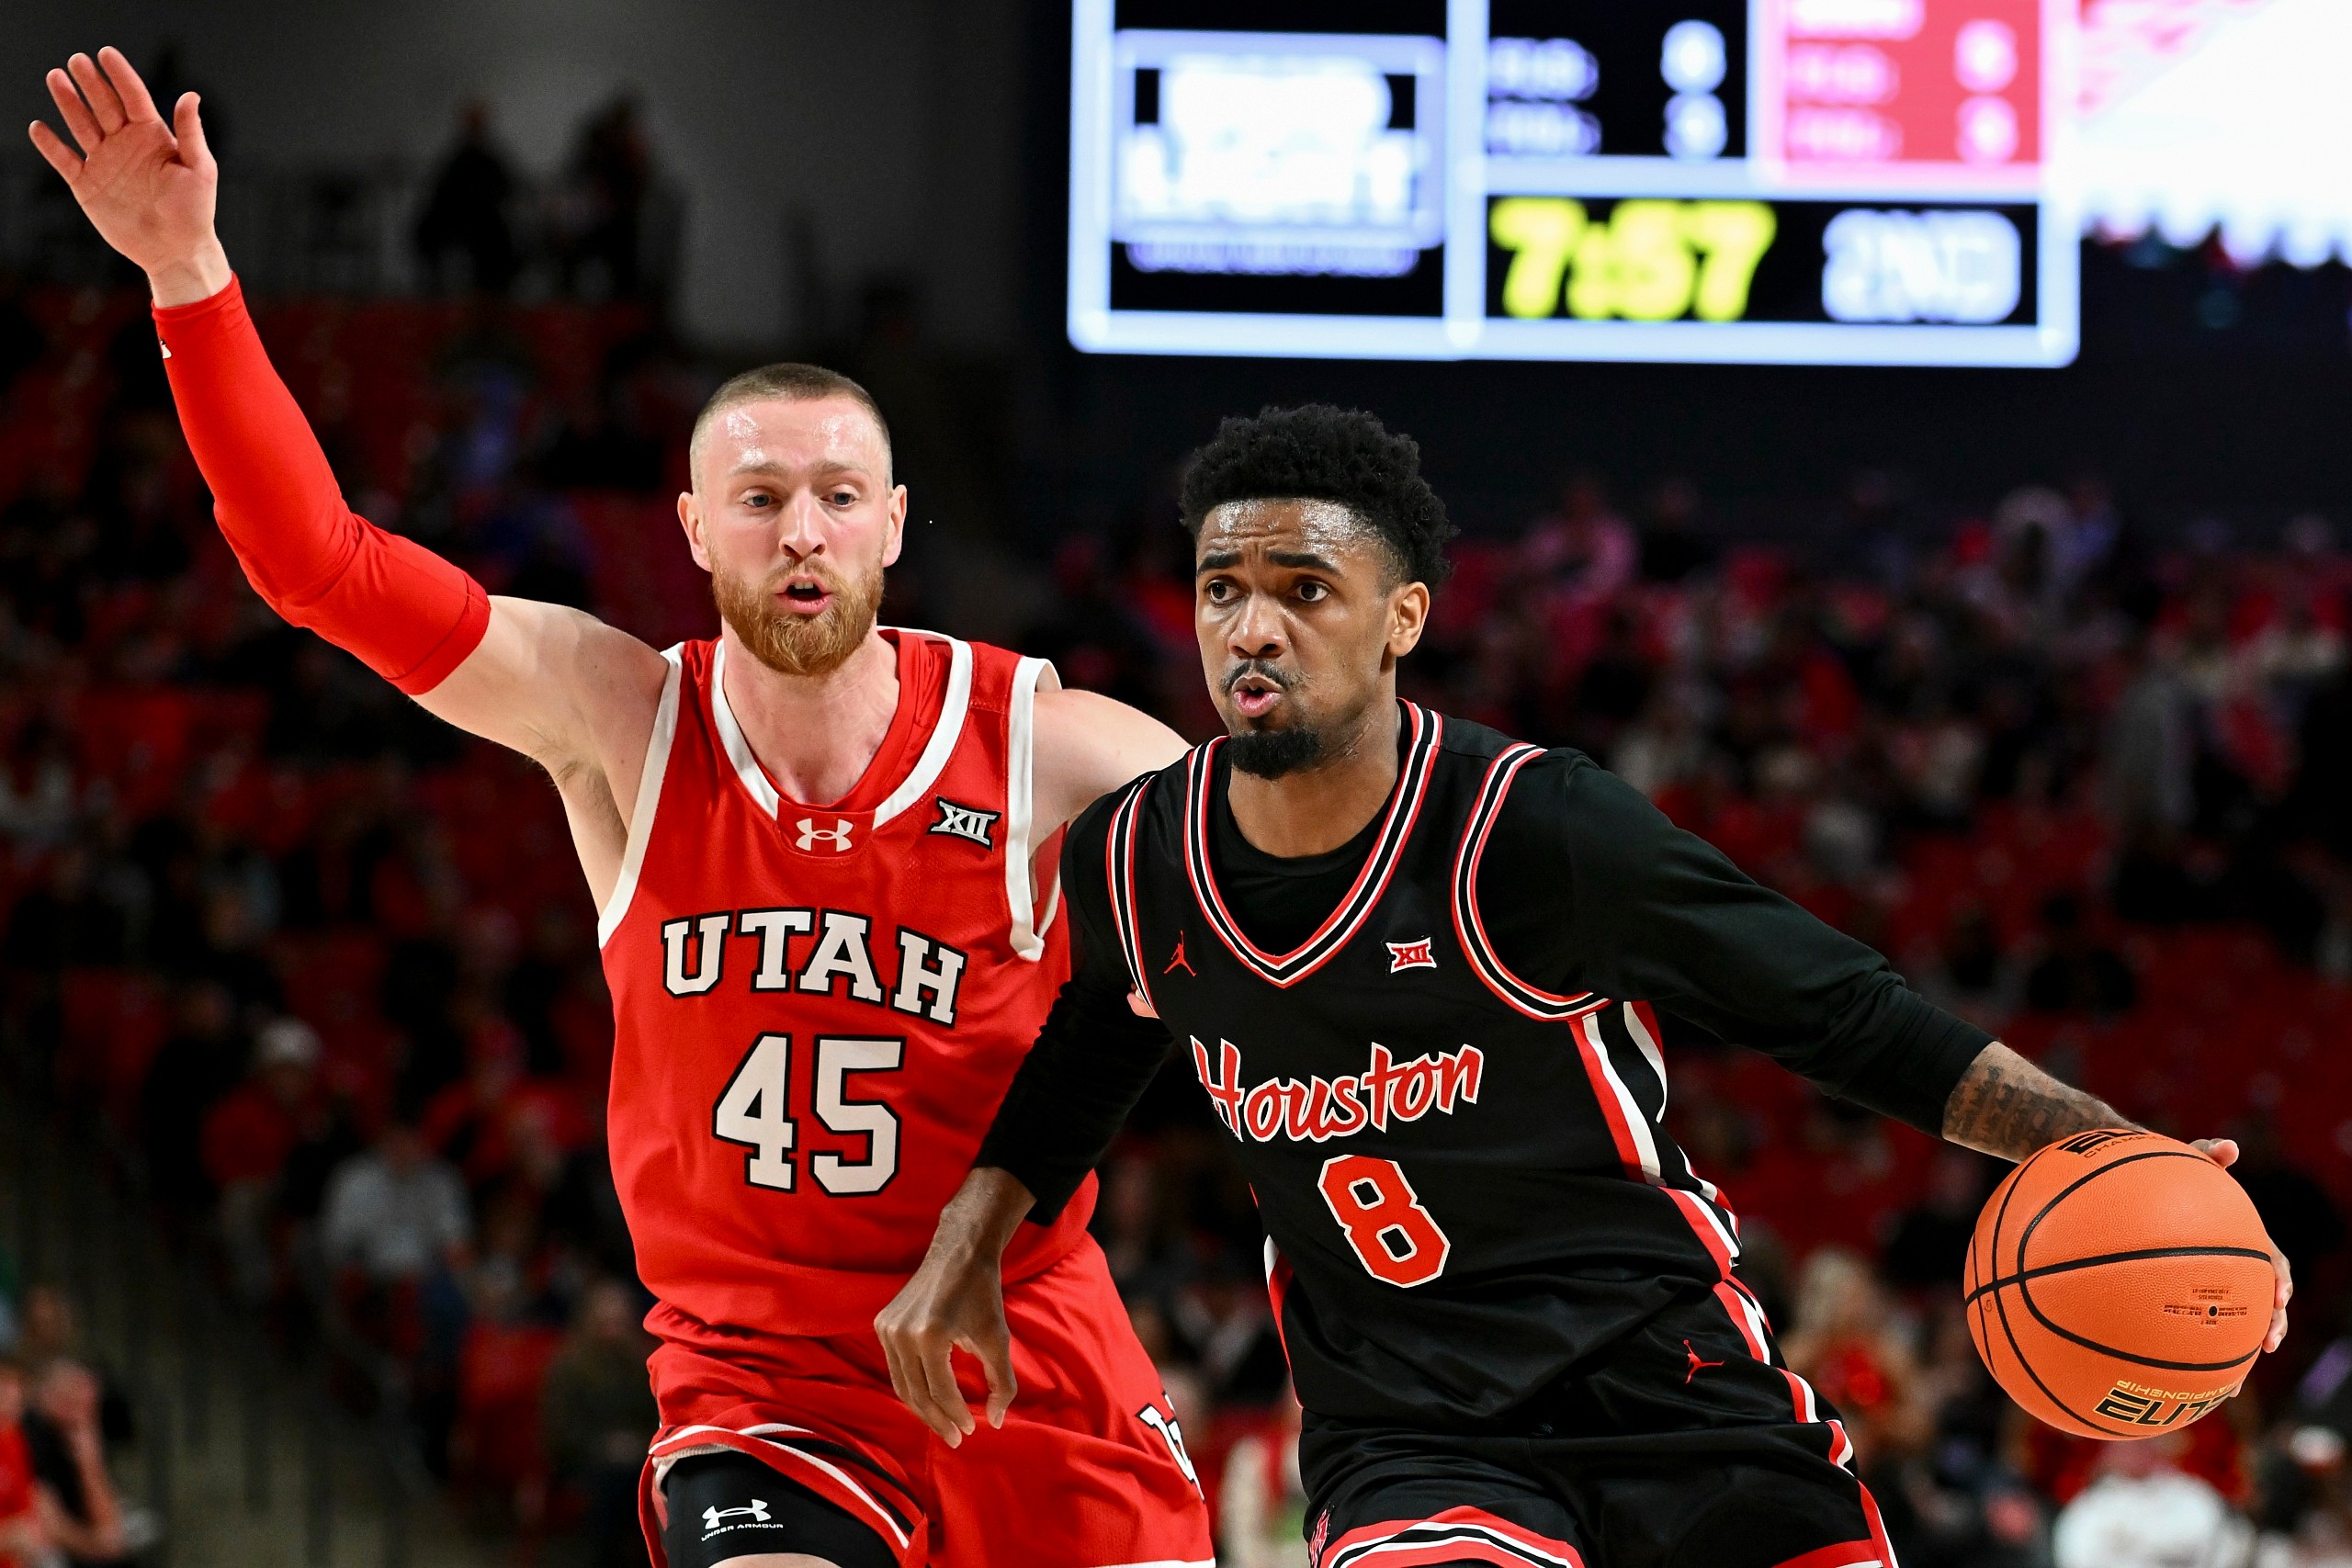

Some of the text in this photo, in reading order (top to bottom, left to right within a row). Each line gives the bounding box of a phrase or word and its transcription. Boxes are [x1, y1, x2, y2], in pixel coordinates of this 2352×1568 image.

[1490, 197, 1777, 321] 7:57
[930, 798, 999, 847] XII
[660, 905, 969, 1029] UTAH
[1389, 941, 1434, 971] XII
[711, 1031, 907, 1198] 45
[1190, 1034, 1484, 1143] Houston
[1317, 1154, 1452, 1289] 8
[2116, 1373, 2243, 1401] HAMPIONSHIP
[701, 1525, 735, 1542] UNDER
